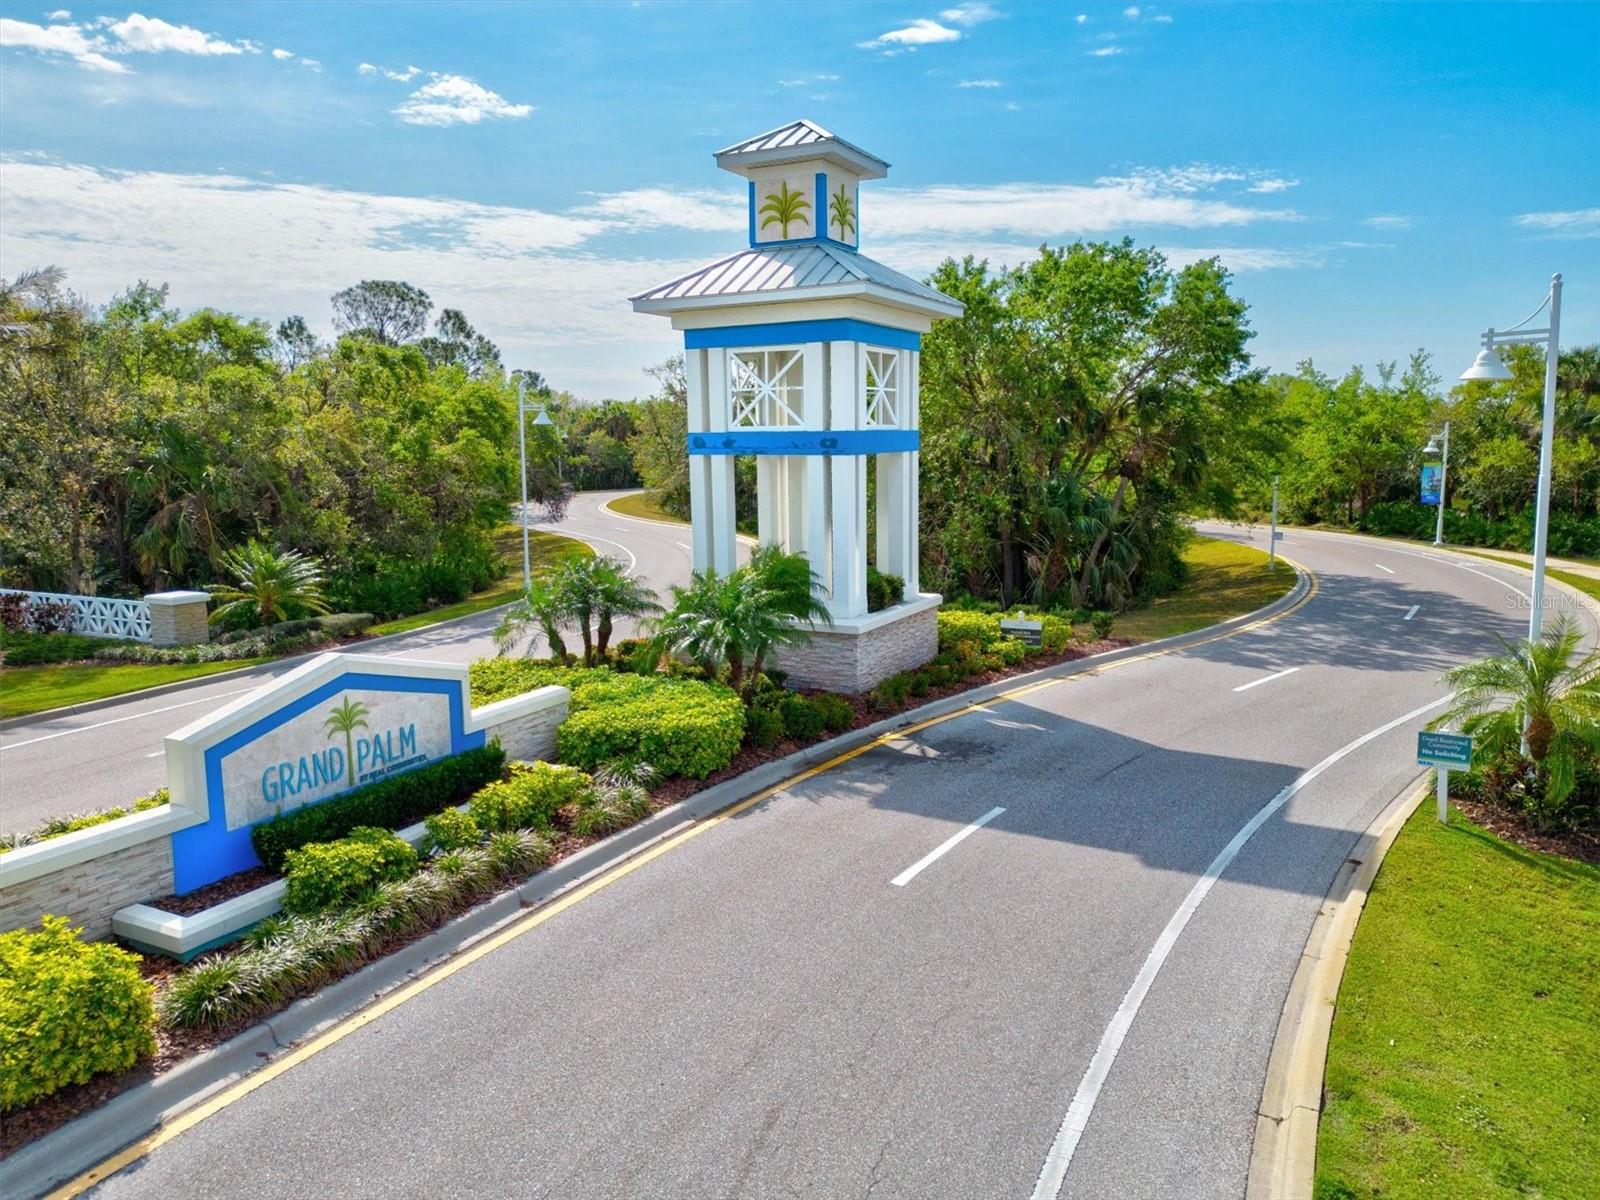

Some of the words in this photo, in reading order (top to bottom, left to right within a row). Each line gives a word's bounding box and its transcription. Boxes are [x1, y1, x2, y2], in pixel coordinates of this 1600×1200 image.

[262, 746, 345, 803] GRAND
[357, 722, 417, 772] PALM
[1434, 750, 1466, 760] Soliciting
